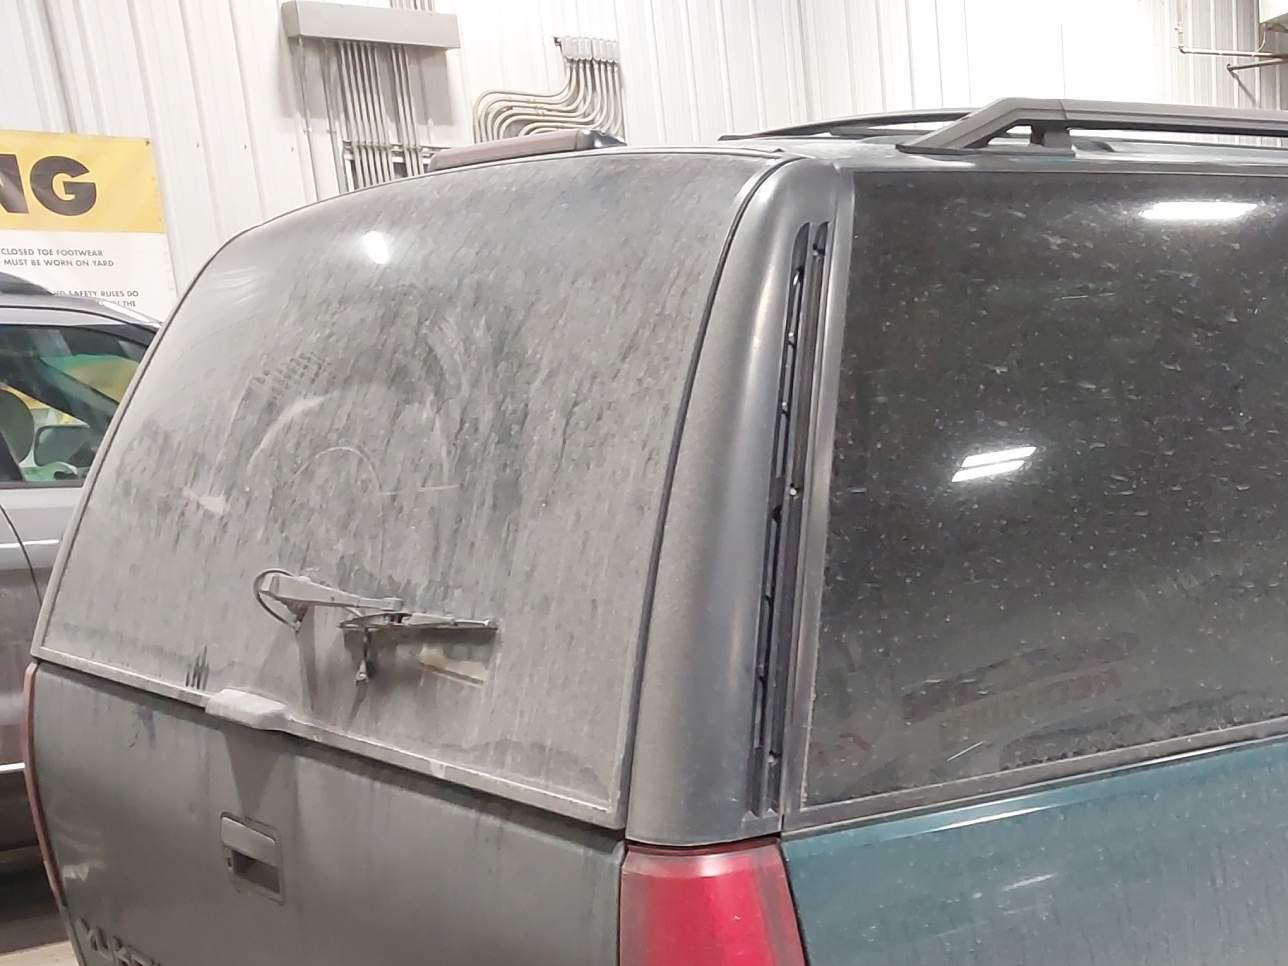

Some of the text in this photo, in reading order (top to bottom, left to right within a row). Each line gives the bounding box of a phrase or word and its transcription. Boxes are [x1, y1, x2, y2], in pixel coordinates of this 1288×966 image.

[0, 247, 104, 257] CLOSED TOE FOOTWEAR
[3, 258, 28, 266] MUST
[31, 258, 41, 266] BE
[44, 259, 73, 267] WORN
[75, 259, 89, 267] ON
